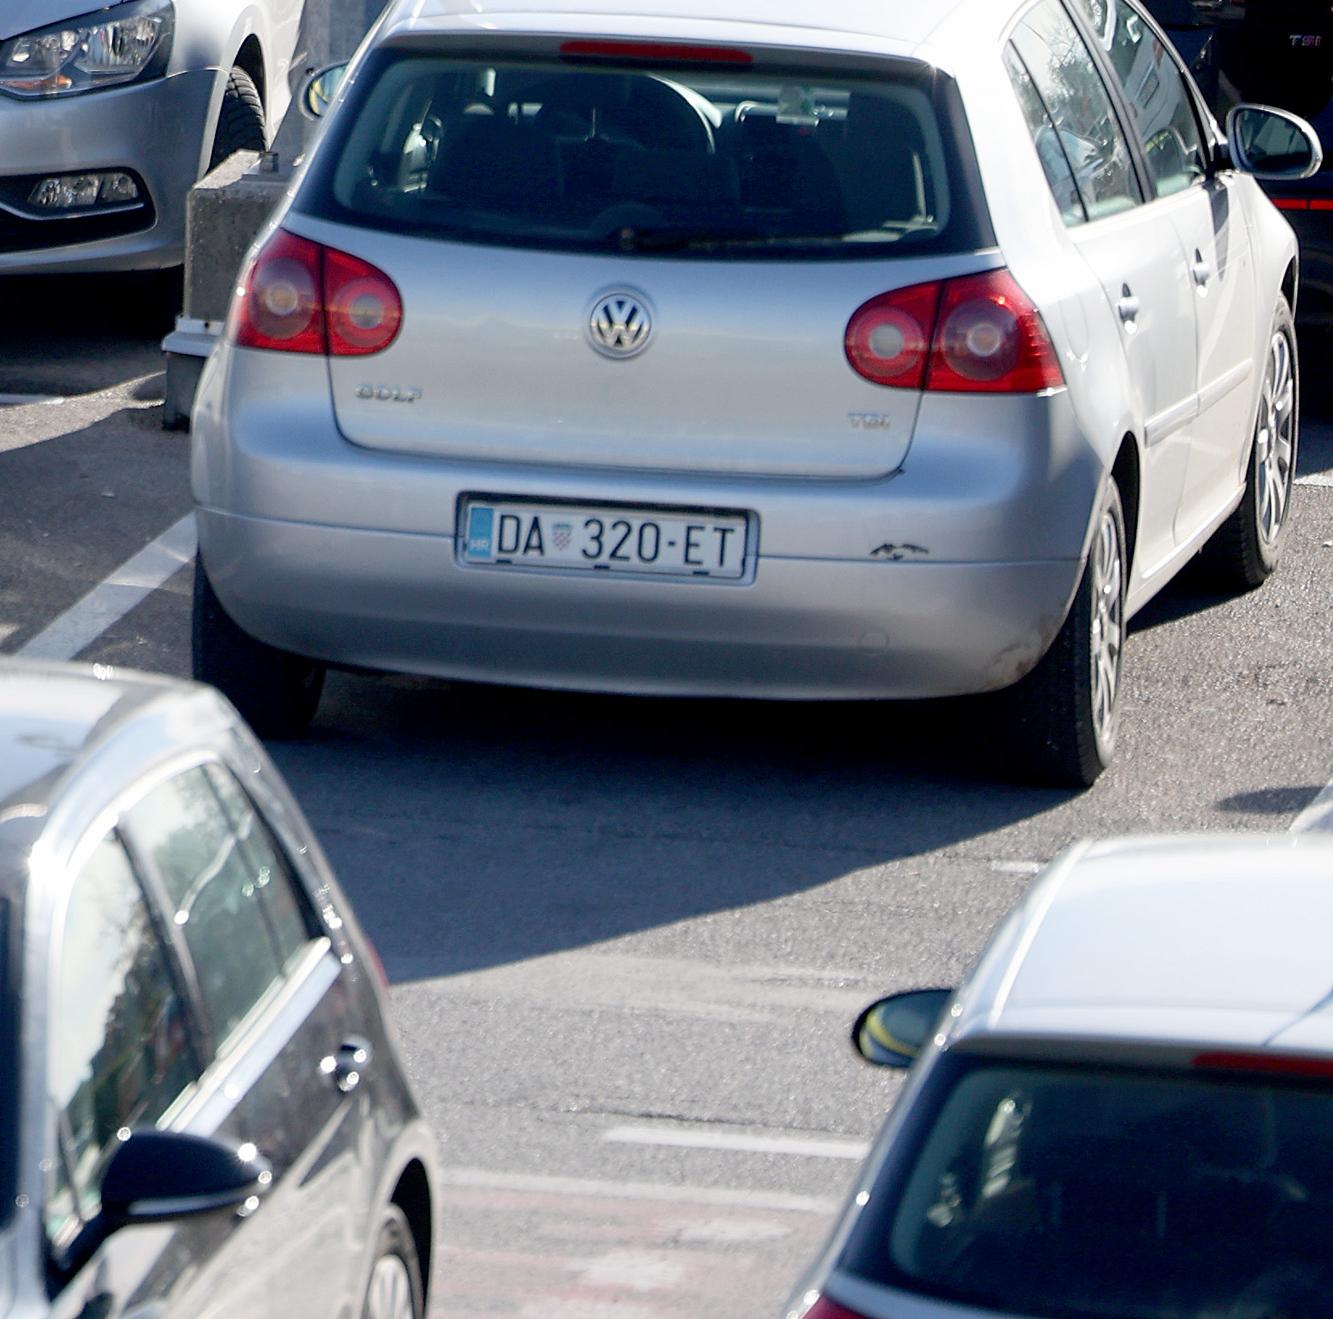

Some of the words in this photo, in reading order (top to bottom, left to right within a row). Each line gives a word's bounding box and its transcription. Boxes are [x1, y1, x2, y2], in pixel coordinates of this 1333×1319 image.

[1289, 34, 1322, 47] TSI
[355, 384, 423, 402] GOLF
[497, 514, 545, 556] DA
[582, 518, 735, 567] 320-ET
